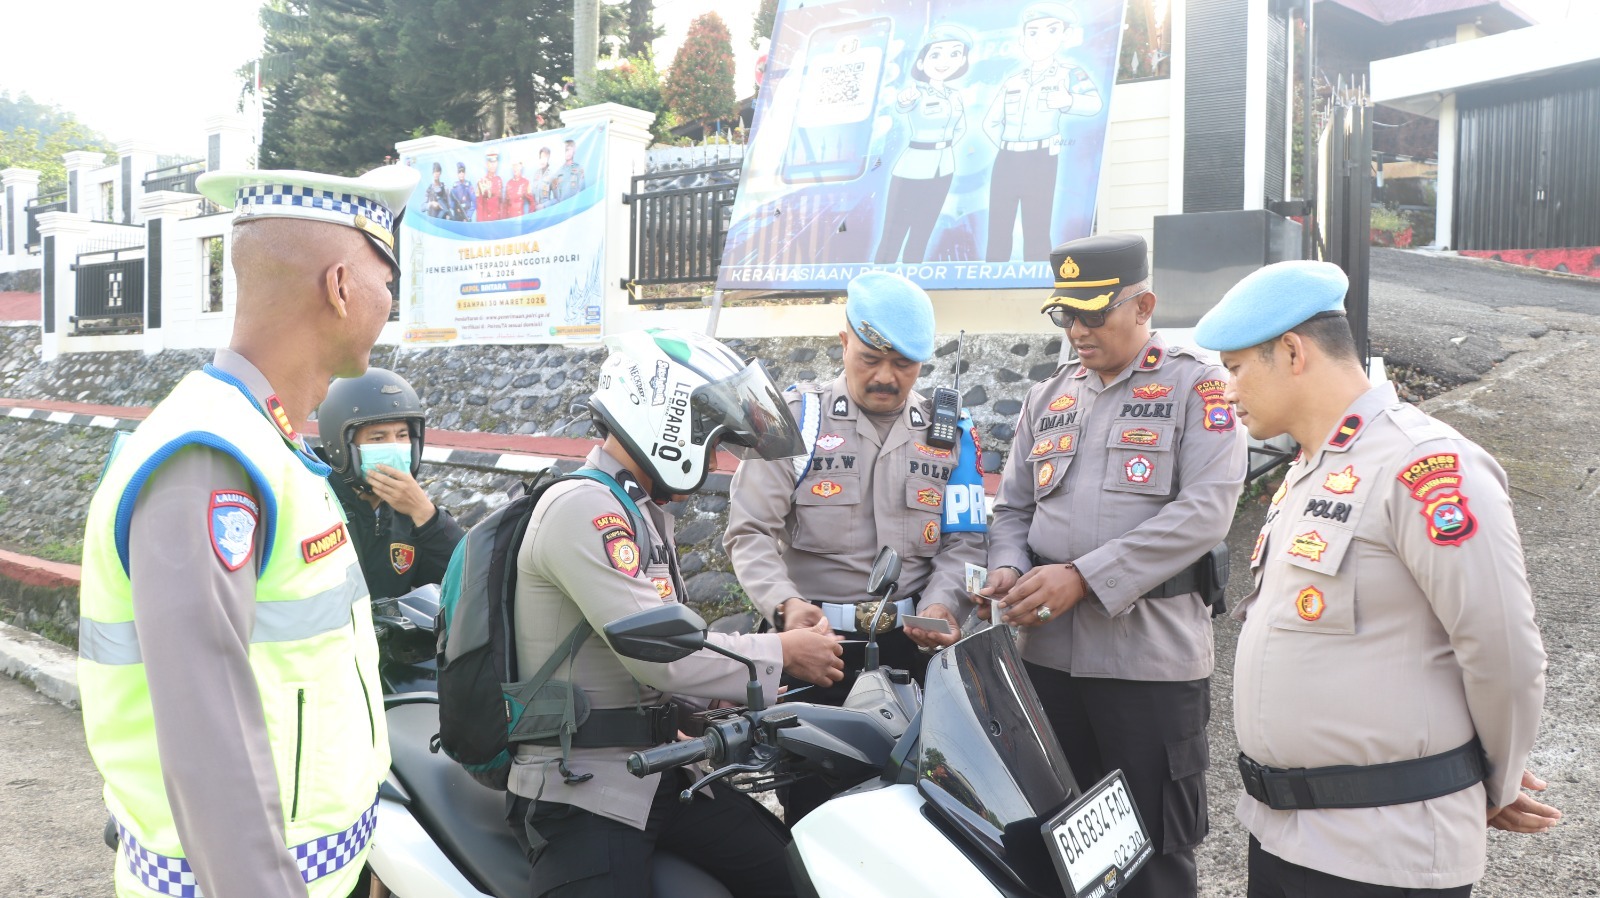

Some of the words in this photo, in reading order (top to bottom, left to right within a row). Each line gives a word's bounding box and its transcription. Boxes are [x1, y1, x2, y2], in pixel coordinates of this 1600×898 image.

[458, 246, 492, 260] TELAH
[494, 240, 540, 257] DIBUKA
[426, 264, 473, 275] PENERIMAAN
[475, 260, 509, 270] TERPADU
[512, 256, 551, 267] ANGGOTA
[553, 254, 580, 264] POLRI
[497, 270, 515, 278] 2026
[731, 267, 853, 281] KERAHASIAAN
[481, 283, 507, 291] BINTARA
[463, 300, 487, 308] SAMPAI
[499, 298, 524, 306] MARET
[526, 296, 545, 304] 2026
[662, 382, 692, 443] LEOPARD
[1119, 402, 1173, 418] POLRI
[1039, 411, 1078, 432] IMAN
[1402, 455, 1455, 482] POLRES
[216, 494, 239, 503] LALU
[1303, 498, 1352, 523] POLRI
[597, 517, 609, 527] SAT
[310, 532, 337, 557] ANDRI
[1059, 827, 1084, 865] BA
[1077, 802, 1111, 848] 6834
[1104, 787, 1131, 826] FAC
